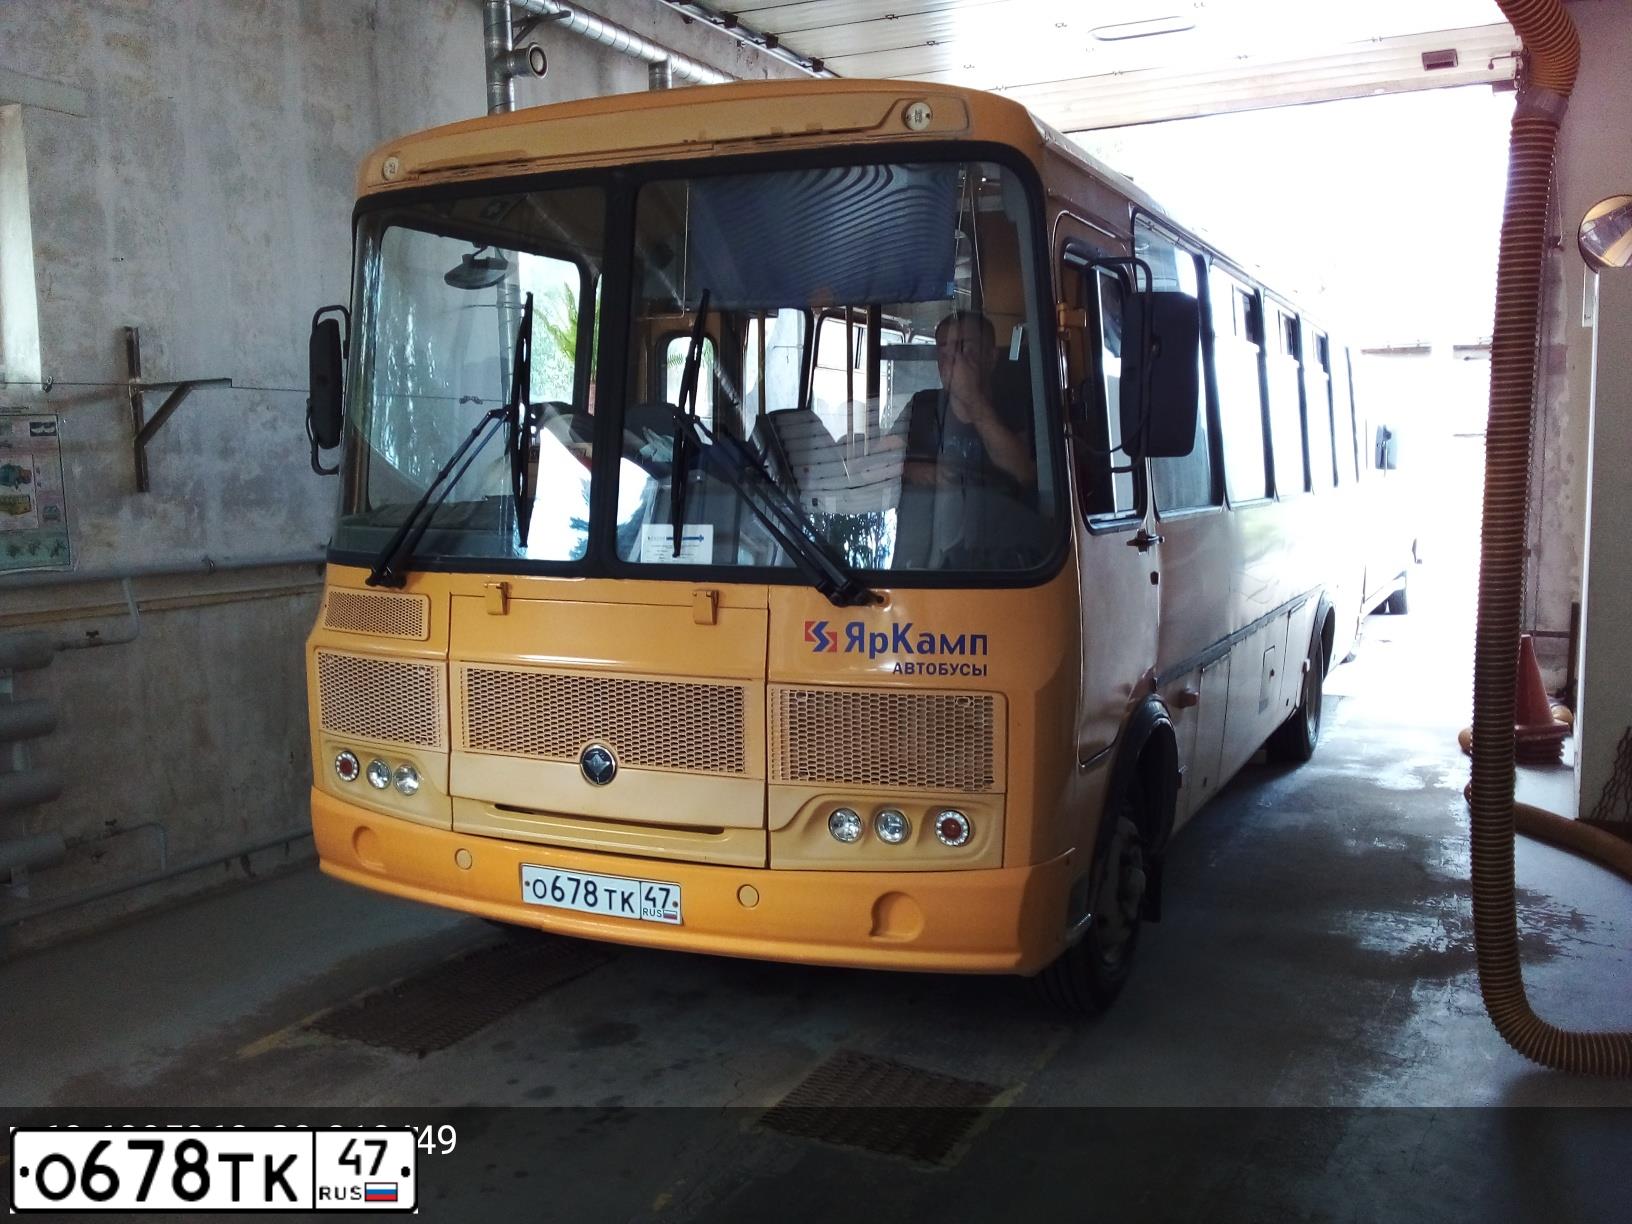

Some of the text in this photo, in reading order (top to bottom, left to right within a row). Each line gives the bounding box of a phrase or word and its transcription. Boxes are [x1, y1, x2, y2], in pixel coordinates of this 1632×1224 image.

[844, 621, 988, 659] ЯрКамп
[892, 662, 987, 676] АВТОБУСЫ
[644, 886, 671, 909] 47
[642, 907, 662, 918] RUS
